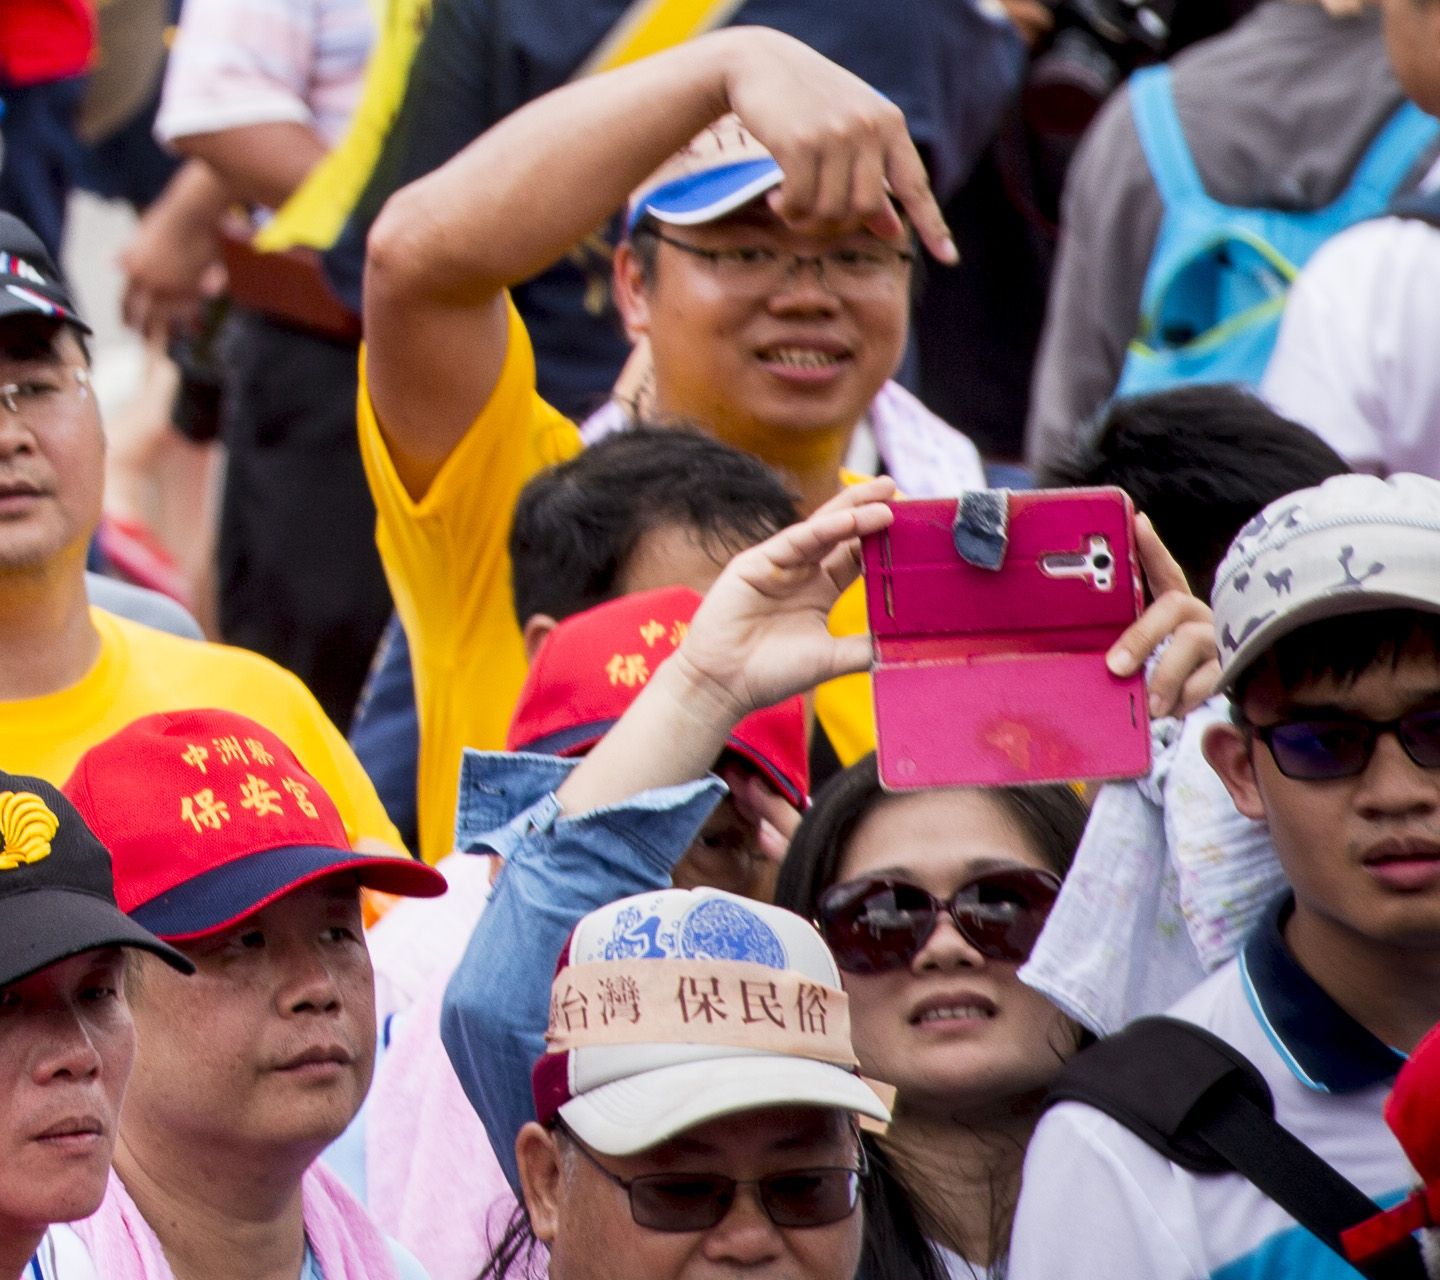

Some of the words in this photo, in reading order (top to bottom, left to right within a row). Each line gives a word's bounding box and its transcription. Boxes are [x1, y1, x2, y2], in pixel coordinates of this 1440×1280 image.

[181, 773, 320, 834] 保安宮
[676, 975, 829, 1036] 保民俗
